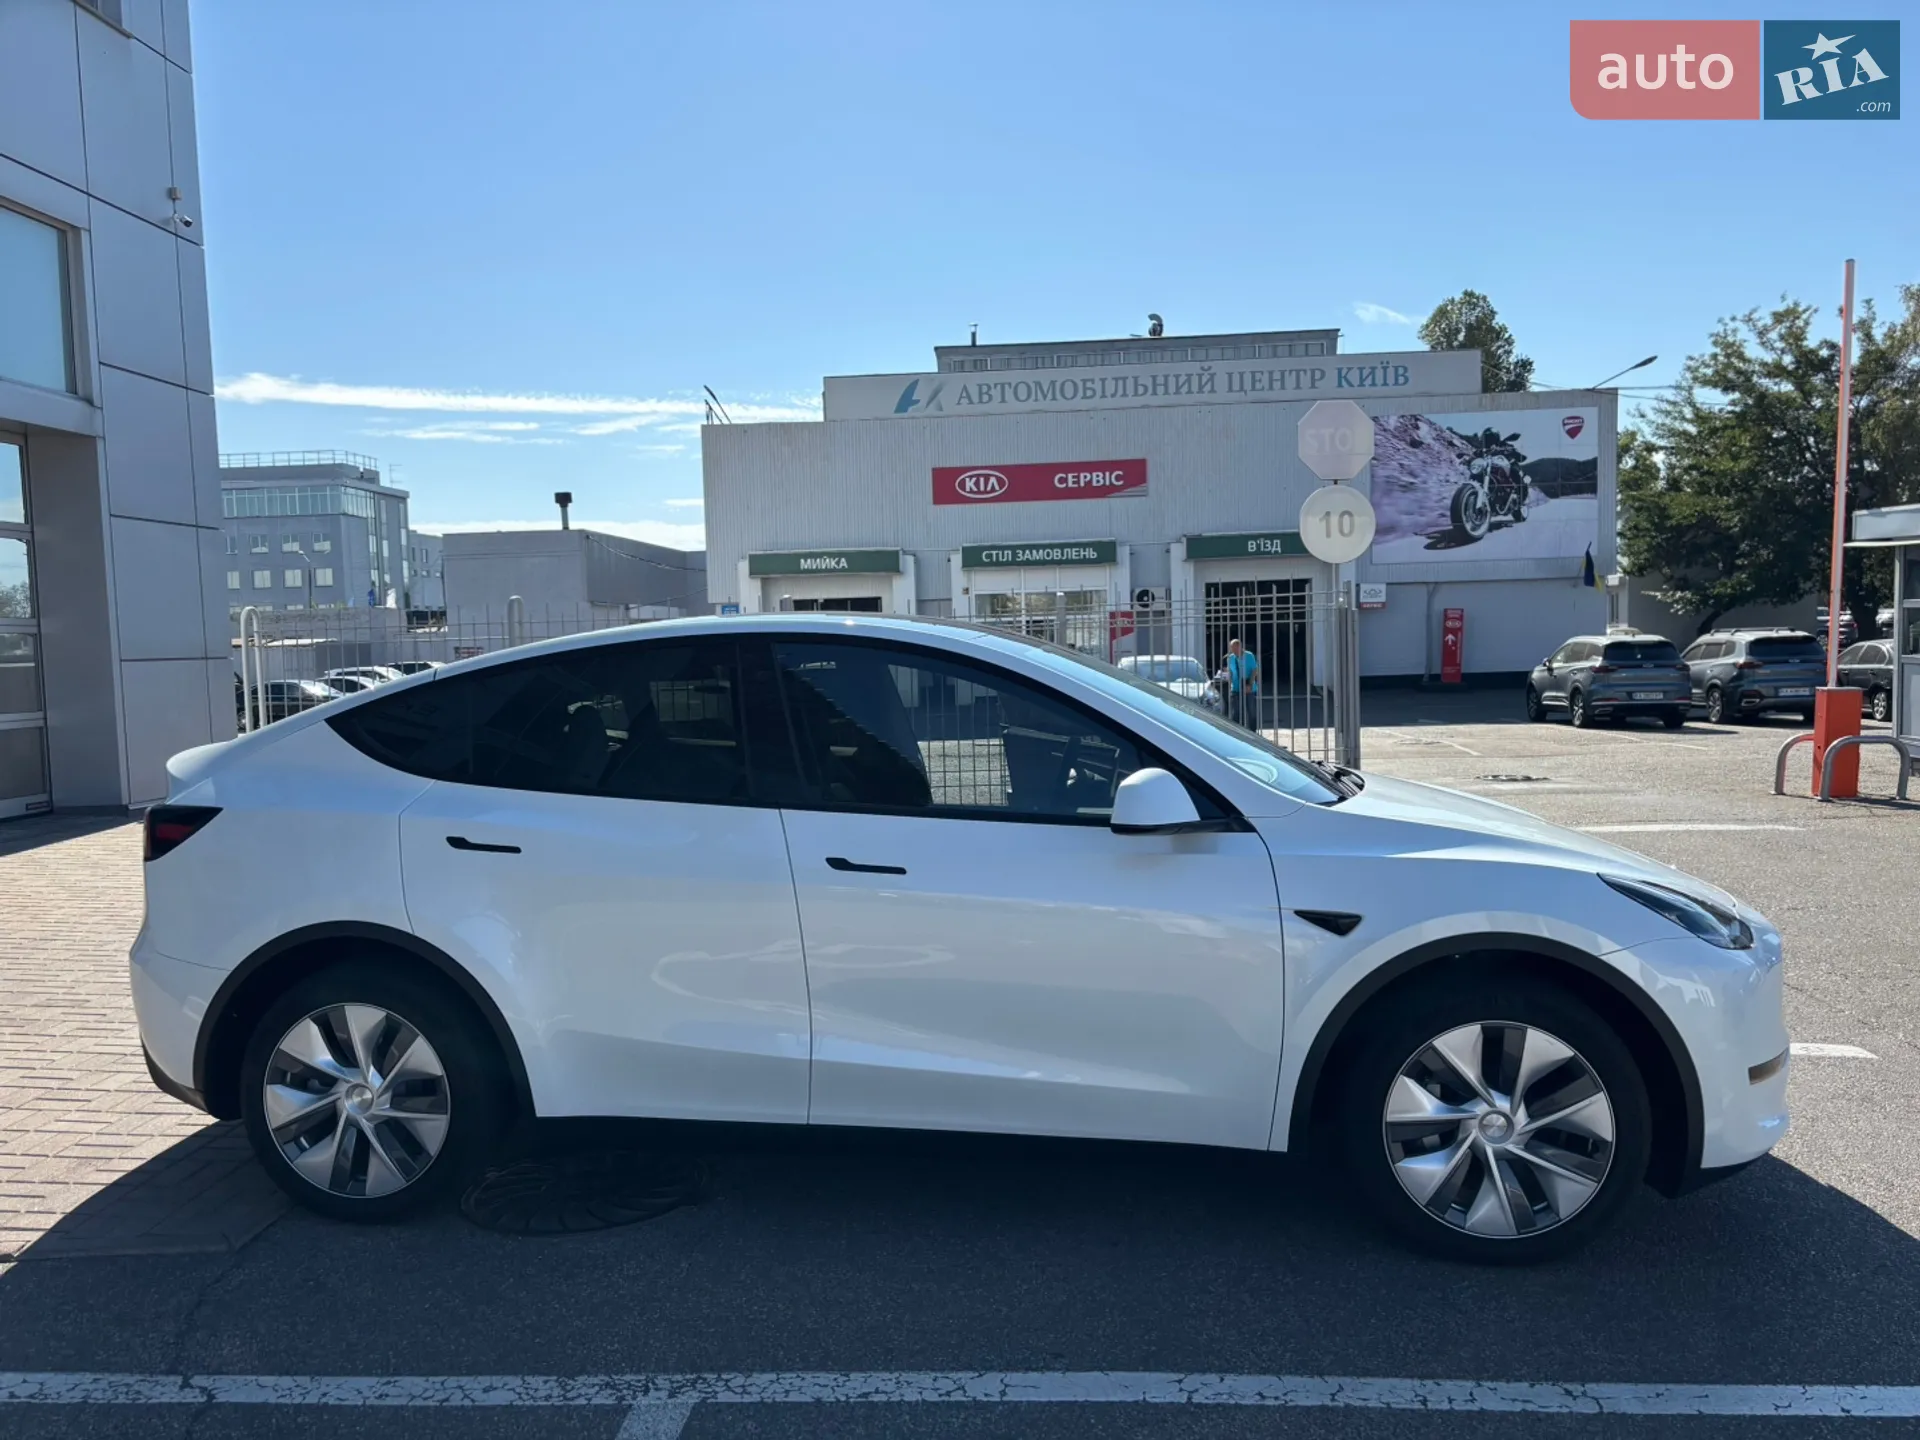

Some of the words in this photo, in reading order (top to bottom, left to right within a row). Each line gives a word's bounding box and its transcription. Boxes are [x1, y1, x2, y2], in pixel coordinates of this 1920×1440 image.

[956, 366, 1217, 405] АВТОМОБІЛЬНИЙ
[1226, 368, 1326, 396] ЦЕНТР
[1336, 361, 1410, 388] КИЇВ
[964, 475, 1000, 493] KIA
[1054, 470, 1124, 488] СЕРВІС
[1318, 510, 1355, 539] 10
[982, 550, 1012, 562] СТІЛ
[1016, 547, 1097, 562] ЗАМОВЛЕНЬ
[1248, 539, 1281, 553] В'ЇЗД
[800, 556, 848, 570] МИЙКА
